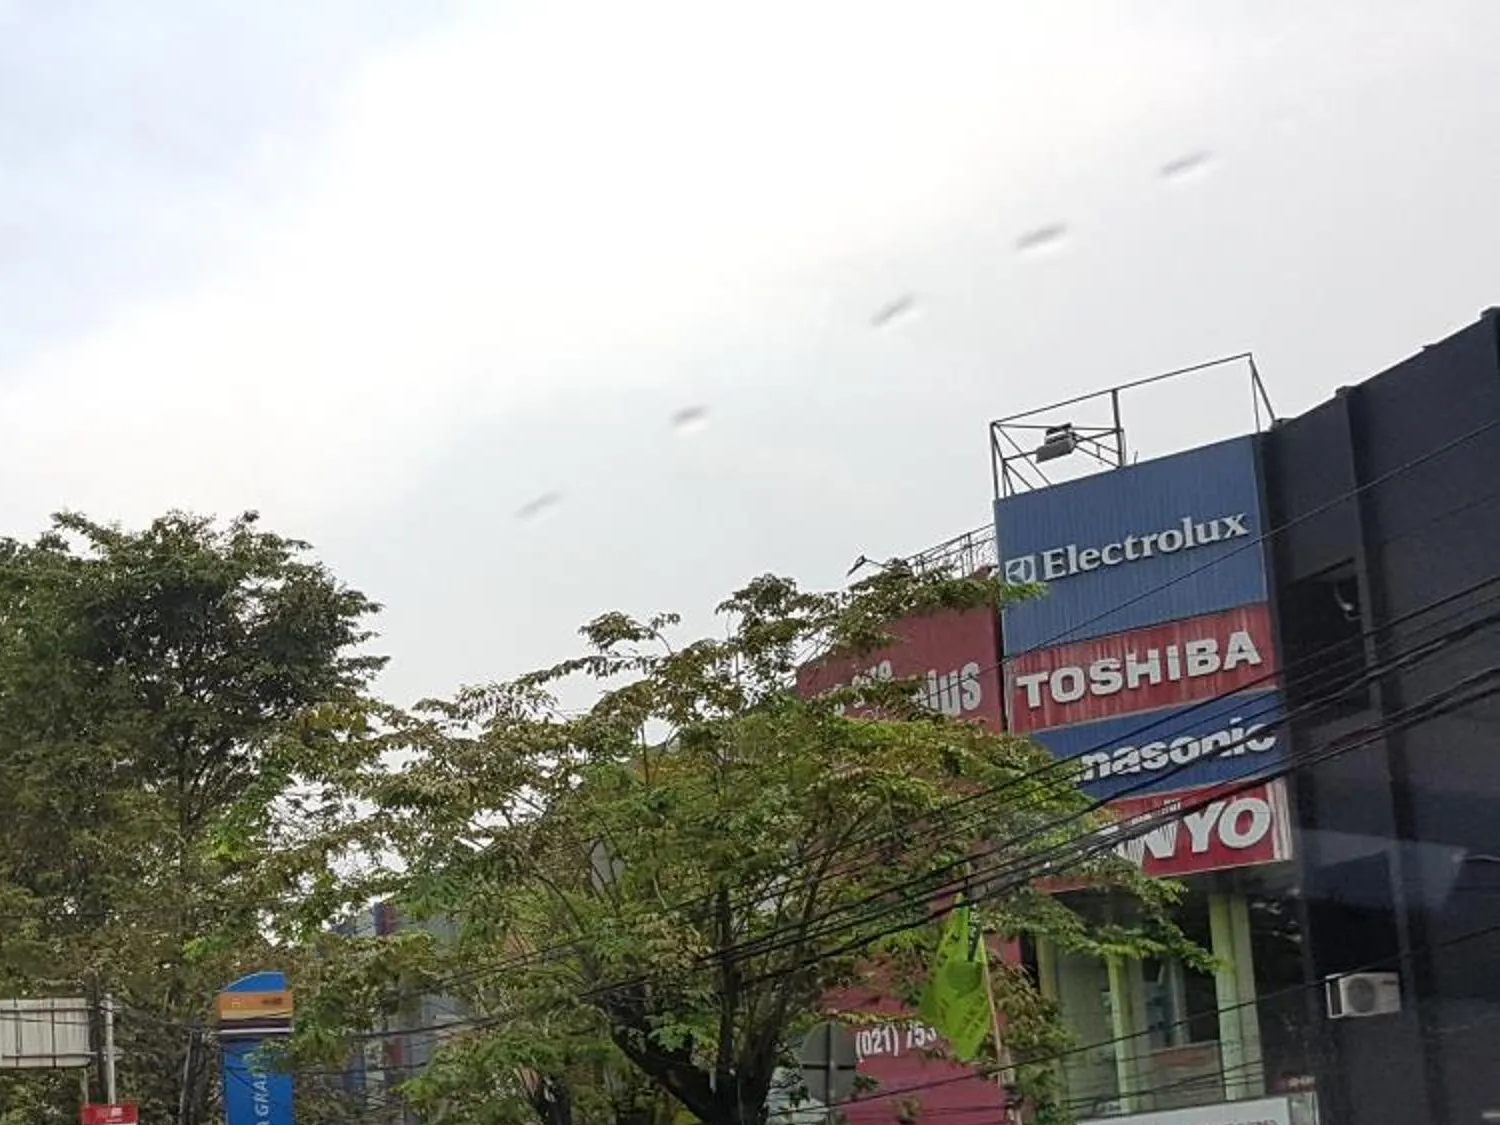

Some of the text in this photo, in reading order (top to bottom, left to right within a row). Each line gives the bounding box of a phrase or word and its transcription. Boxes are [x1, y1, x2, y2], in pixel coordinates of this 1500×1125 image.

[1041, 512, 1250, 581] Electrolux
[1016, 631, 1263, 709] TOSHIBA
[1073, 717, 1277, 782] nasonic
[1104, 797, 1271, 868] NYO
[855, 1022, 899, 1062] (021)
[252, 1068, 270, 1116] GRA
